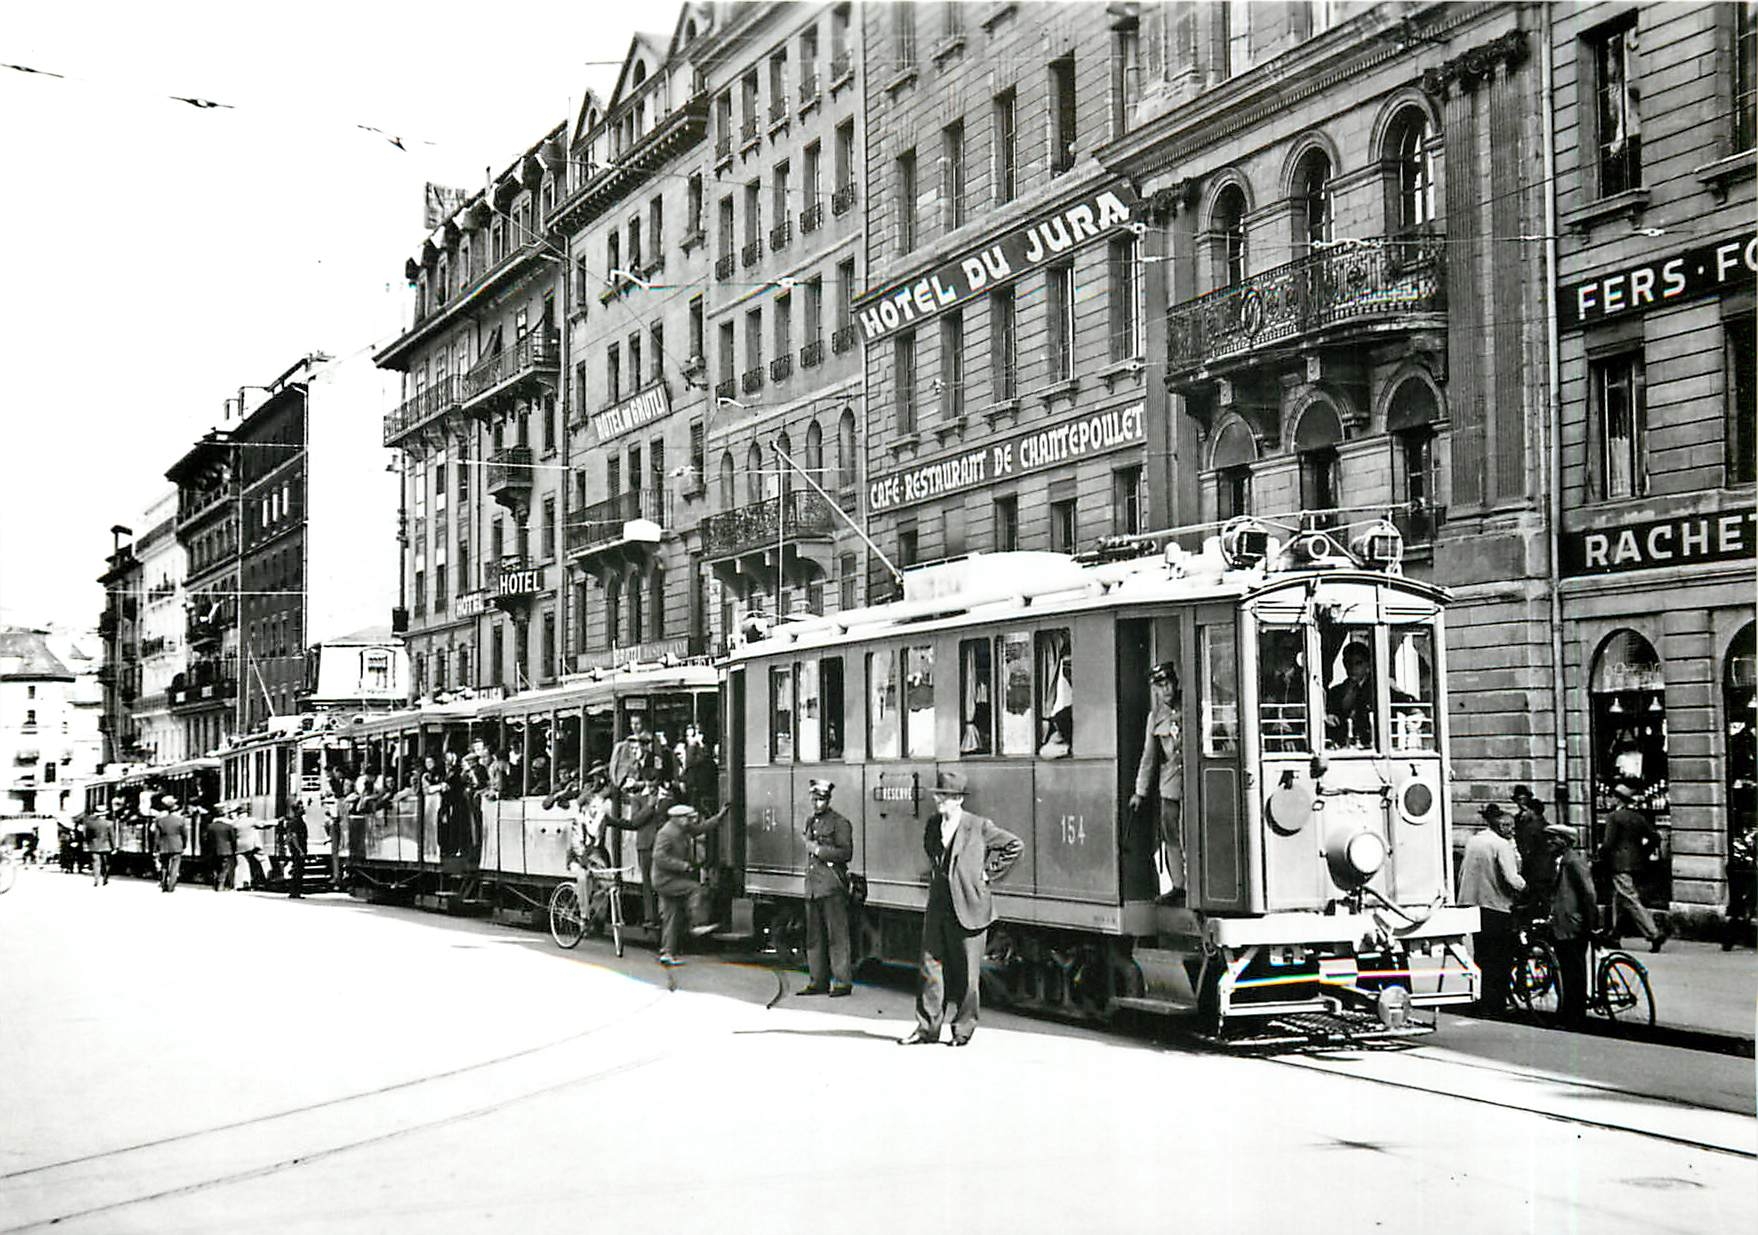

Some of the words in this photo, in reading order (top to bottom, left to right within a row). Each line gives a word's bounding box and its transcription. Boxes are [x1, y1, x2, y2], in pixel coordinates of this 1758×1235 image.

[860, 275, 957, 338] HOTEL
[961, 245, 1011, 291] DU
[1026, 191, 1130, 262] JURA
[1578, 259, 1686, 320] FERS
[993, 444, 1013, 477] DE
[1020, 402, 1145, 468] CHANTEPOULET
[1585, 513, 1757, 568] RACHE
[500, 570, 540, 595] HOTEL
[1061, 814, 1086, 845] 154
